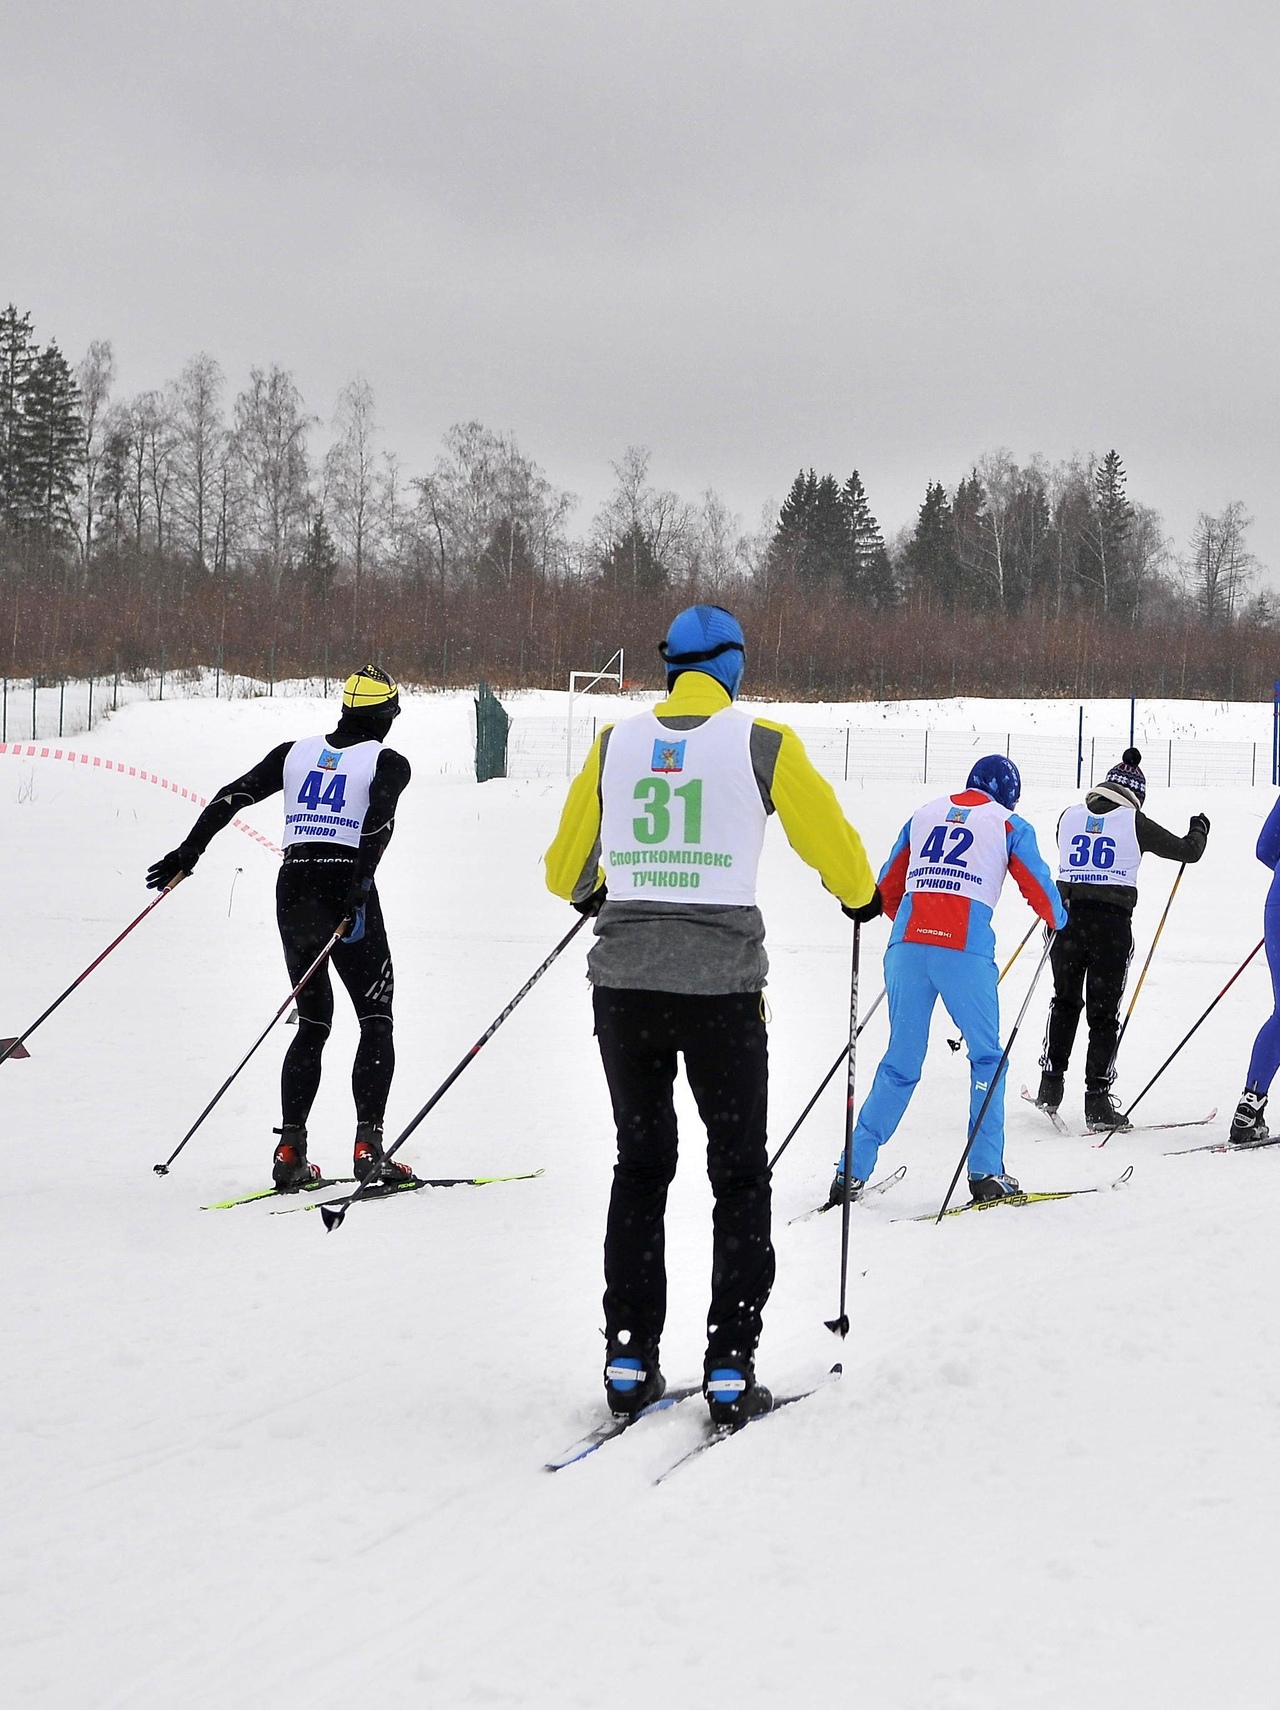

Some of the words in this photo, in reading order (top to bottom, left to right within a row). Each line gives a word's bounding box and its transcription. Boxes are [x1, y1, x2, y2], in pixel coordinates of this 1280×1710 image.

[297, 770, 347, 813] 44
[632, 777, 703, 845] 31
[286, 813, 360, 829] Спорткомплекс
[294, 825, 337, 837] ТУЧКОВО
[920, 825, 975, 868] 42
[1069, 834, 1116, 869] 36
[609, 850, 733, 868] Спорткомплекс
[632, 871, 700, 888] ТУЧКОВО
[916, 879, 961, 892] ТУЧКОВО
